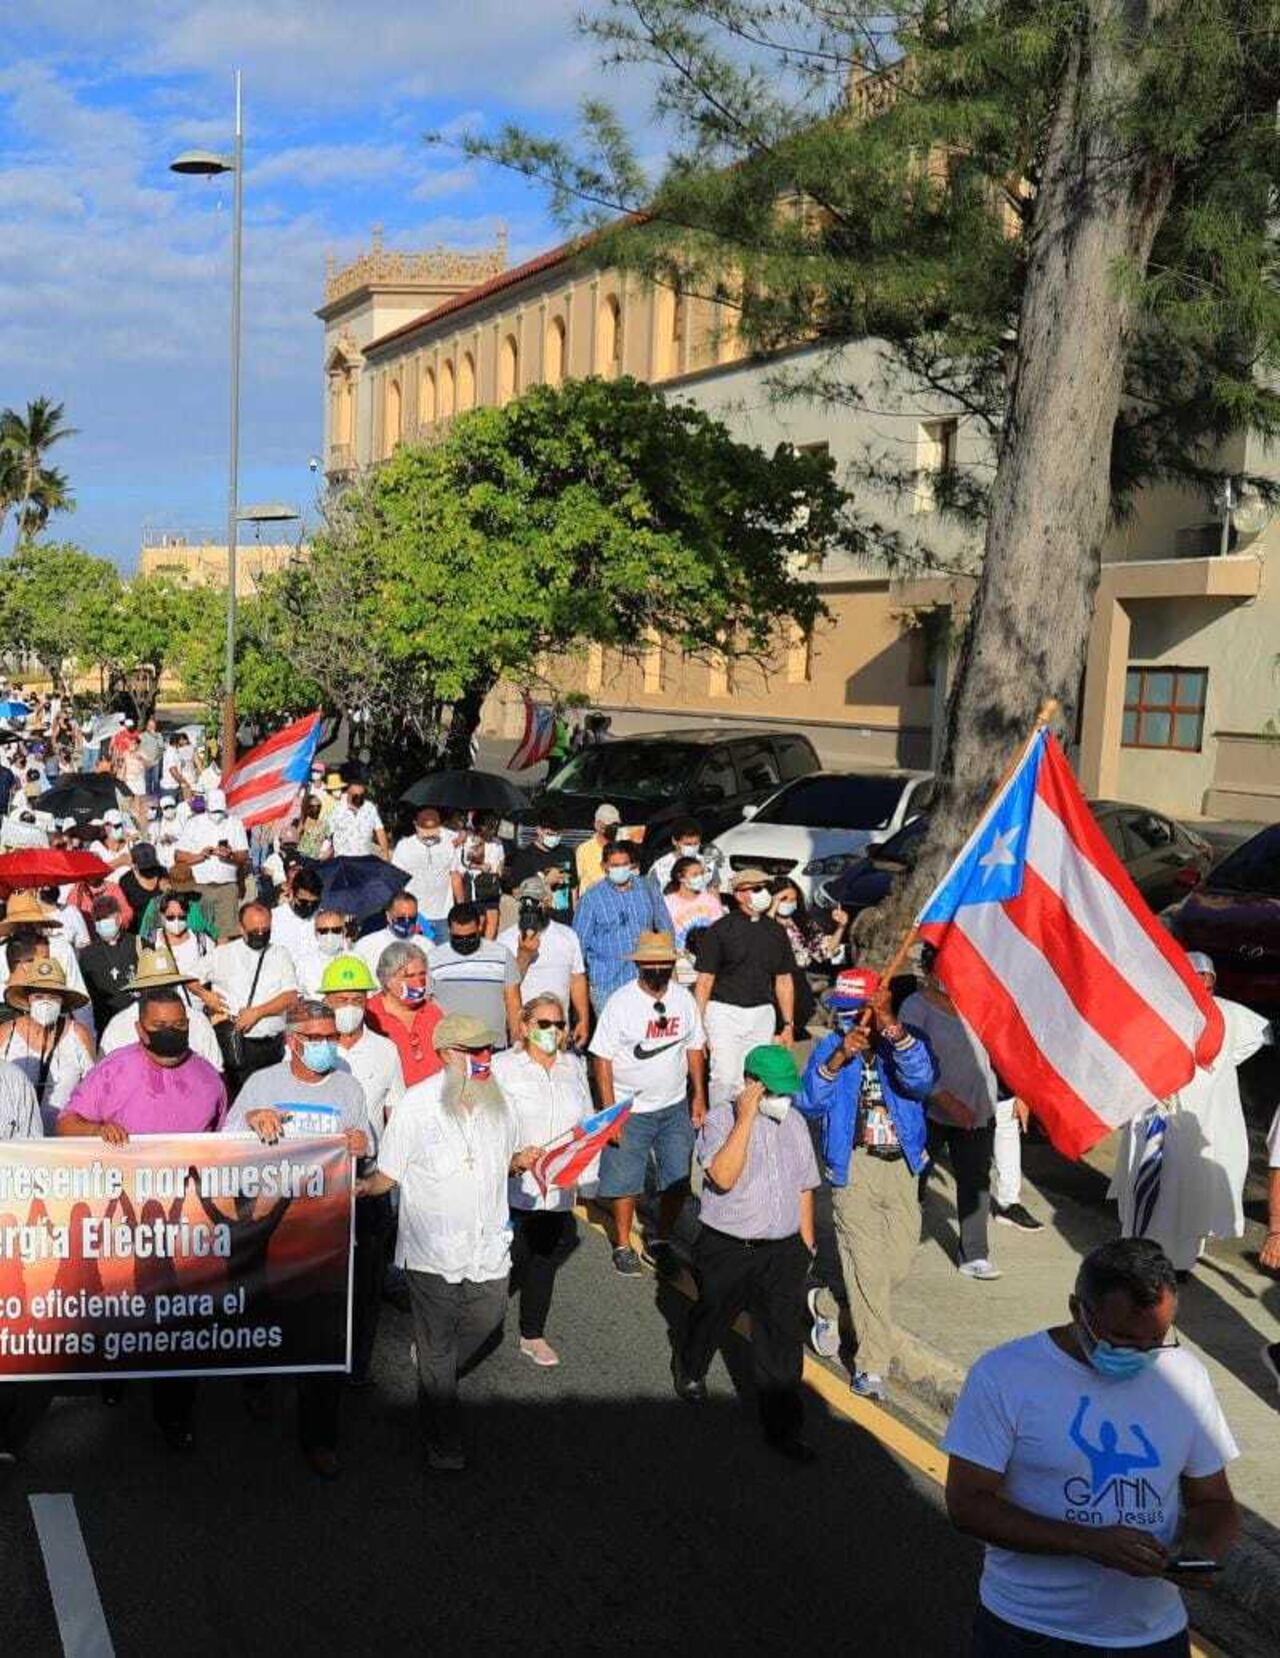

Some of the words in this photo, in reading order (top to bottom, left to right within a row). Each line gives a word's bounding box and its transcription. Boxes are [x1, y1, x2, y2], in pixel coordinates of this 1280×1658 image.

[646, 1016, 680, 1039] NIKE
[135, 1166, 188, 1208] por
[199, 1159, 326, 1198] nuestra
[81, 1214, 232, 1260] Eléctrica
[30, 1290, 146, 1319] eficiente
[155, 1296, 215, 1322] para
[223, 1287, 245, 1314] el
[0, 1328, 95, 1354] futuras
[104, 1323, 282, 1358] generaciones
[1065, 1508, 1103, 1524] con
